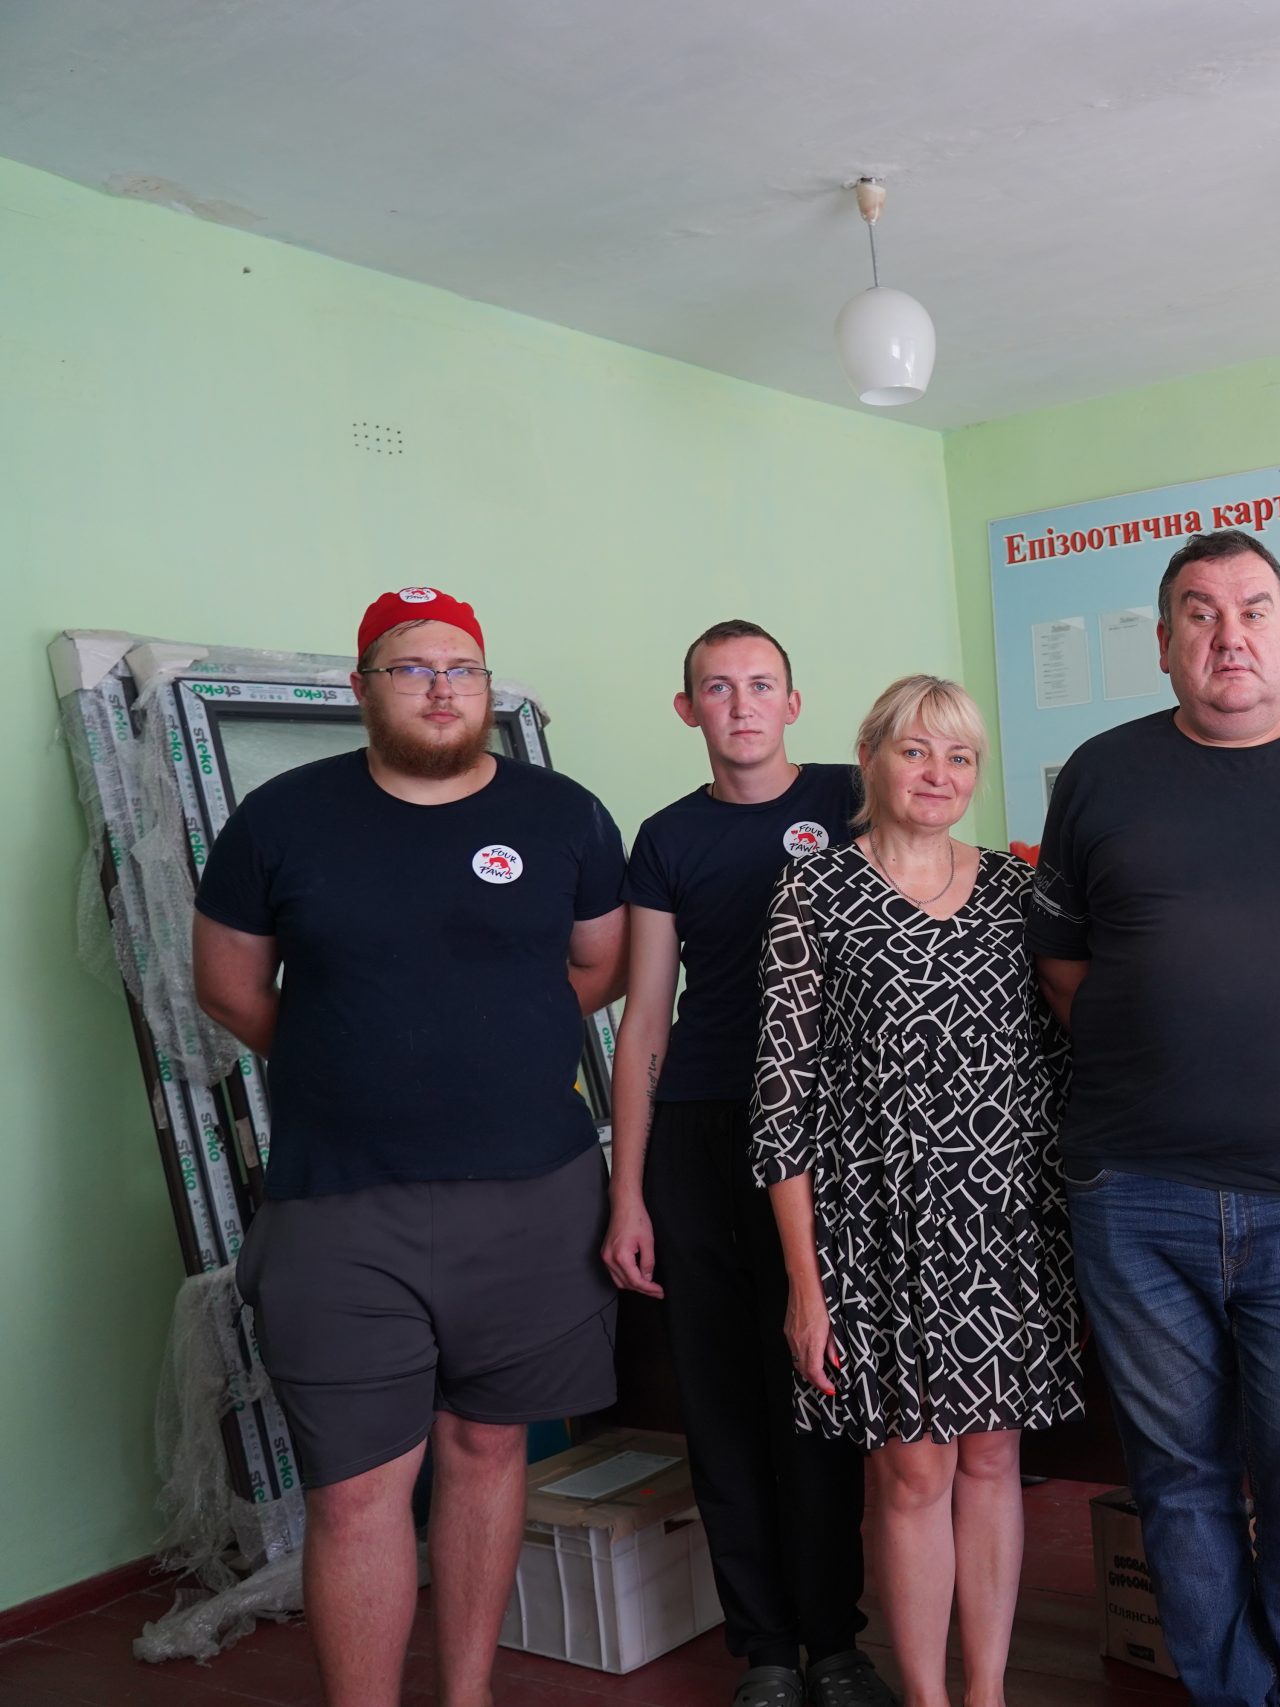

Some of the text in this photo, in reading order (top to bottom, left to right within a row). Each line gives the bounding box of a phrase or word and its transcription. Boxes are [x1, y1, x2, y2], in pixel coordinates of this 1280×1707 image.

[1004, 510, 1202, 565] Епізоотична
[192, 683, 241, 697] steko
[293, 688, 337, 701] steko
[108, 694, 128, 741] steko
[167, 714, 183, 762] steko
[193, 727, 213, 775] steko
[186, 817, 206, 865] steko
[789, 842, 821, 855] PAWS
[799, 824, 823, 838] FOUR
[480, 866, 513, 880] PAWS
[491, 848, 517, 864] FOUR
[201, 1112, 221, 1162] steko
[177, 1139, 197, 1191] steko
[273, 1436, 294, 1489] steko
[250, 1470, 266, 1503] ste
